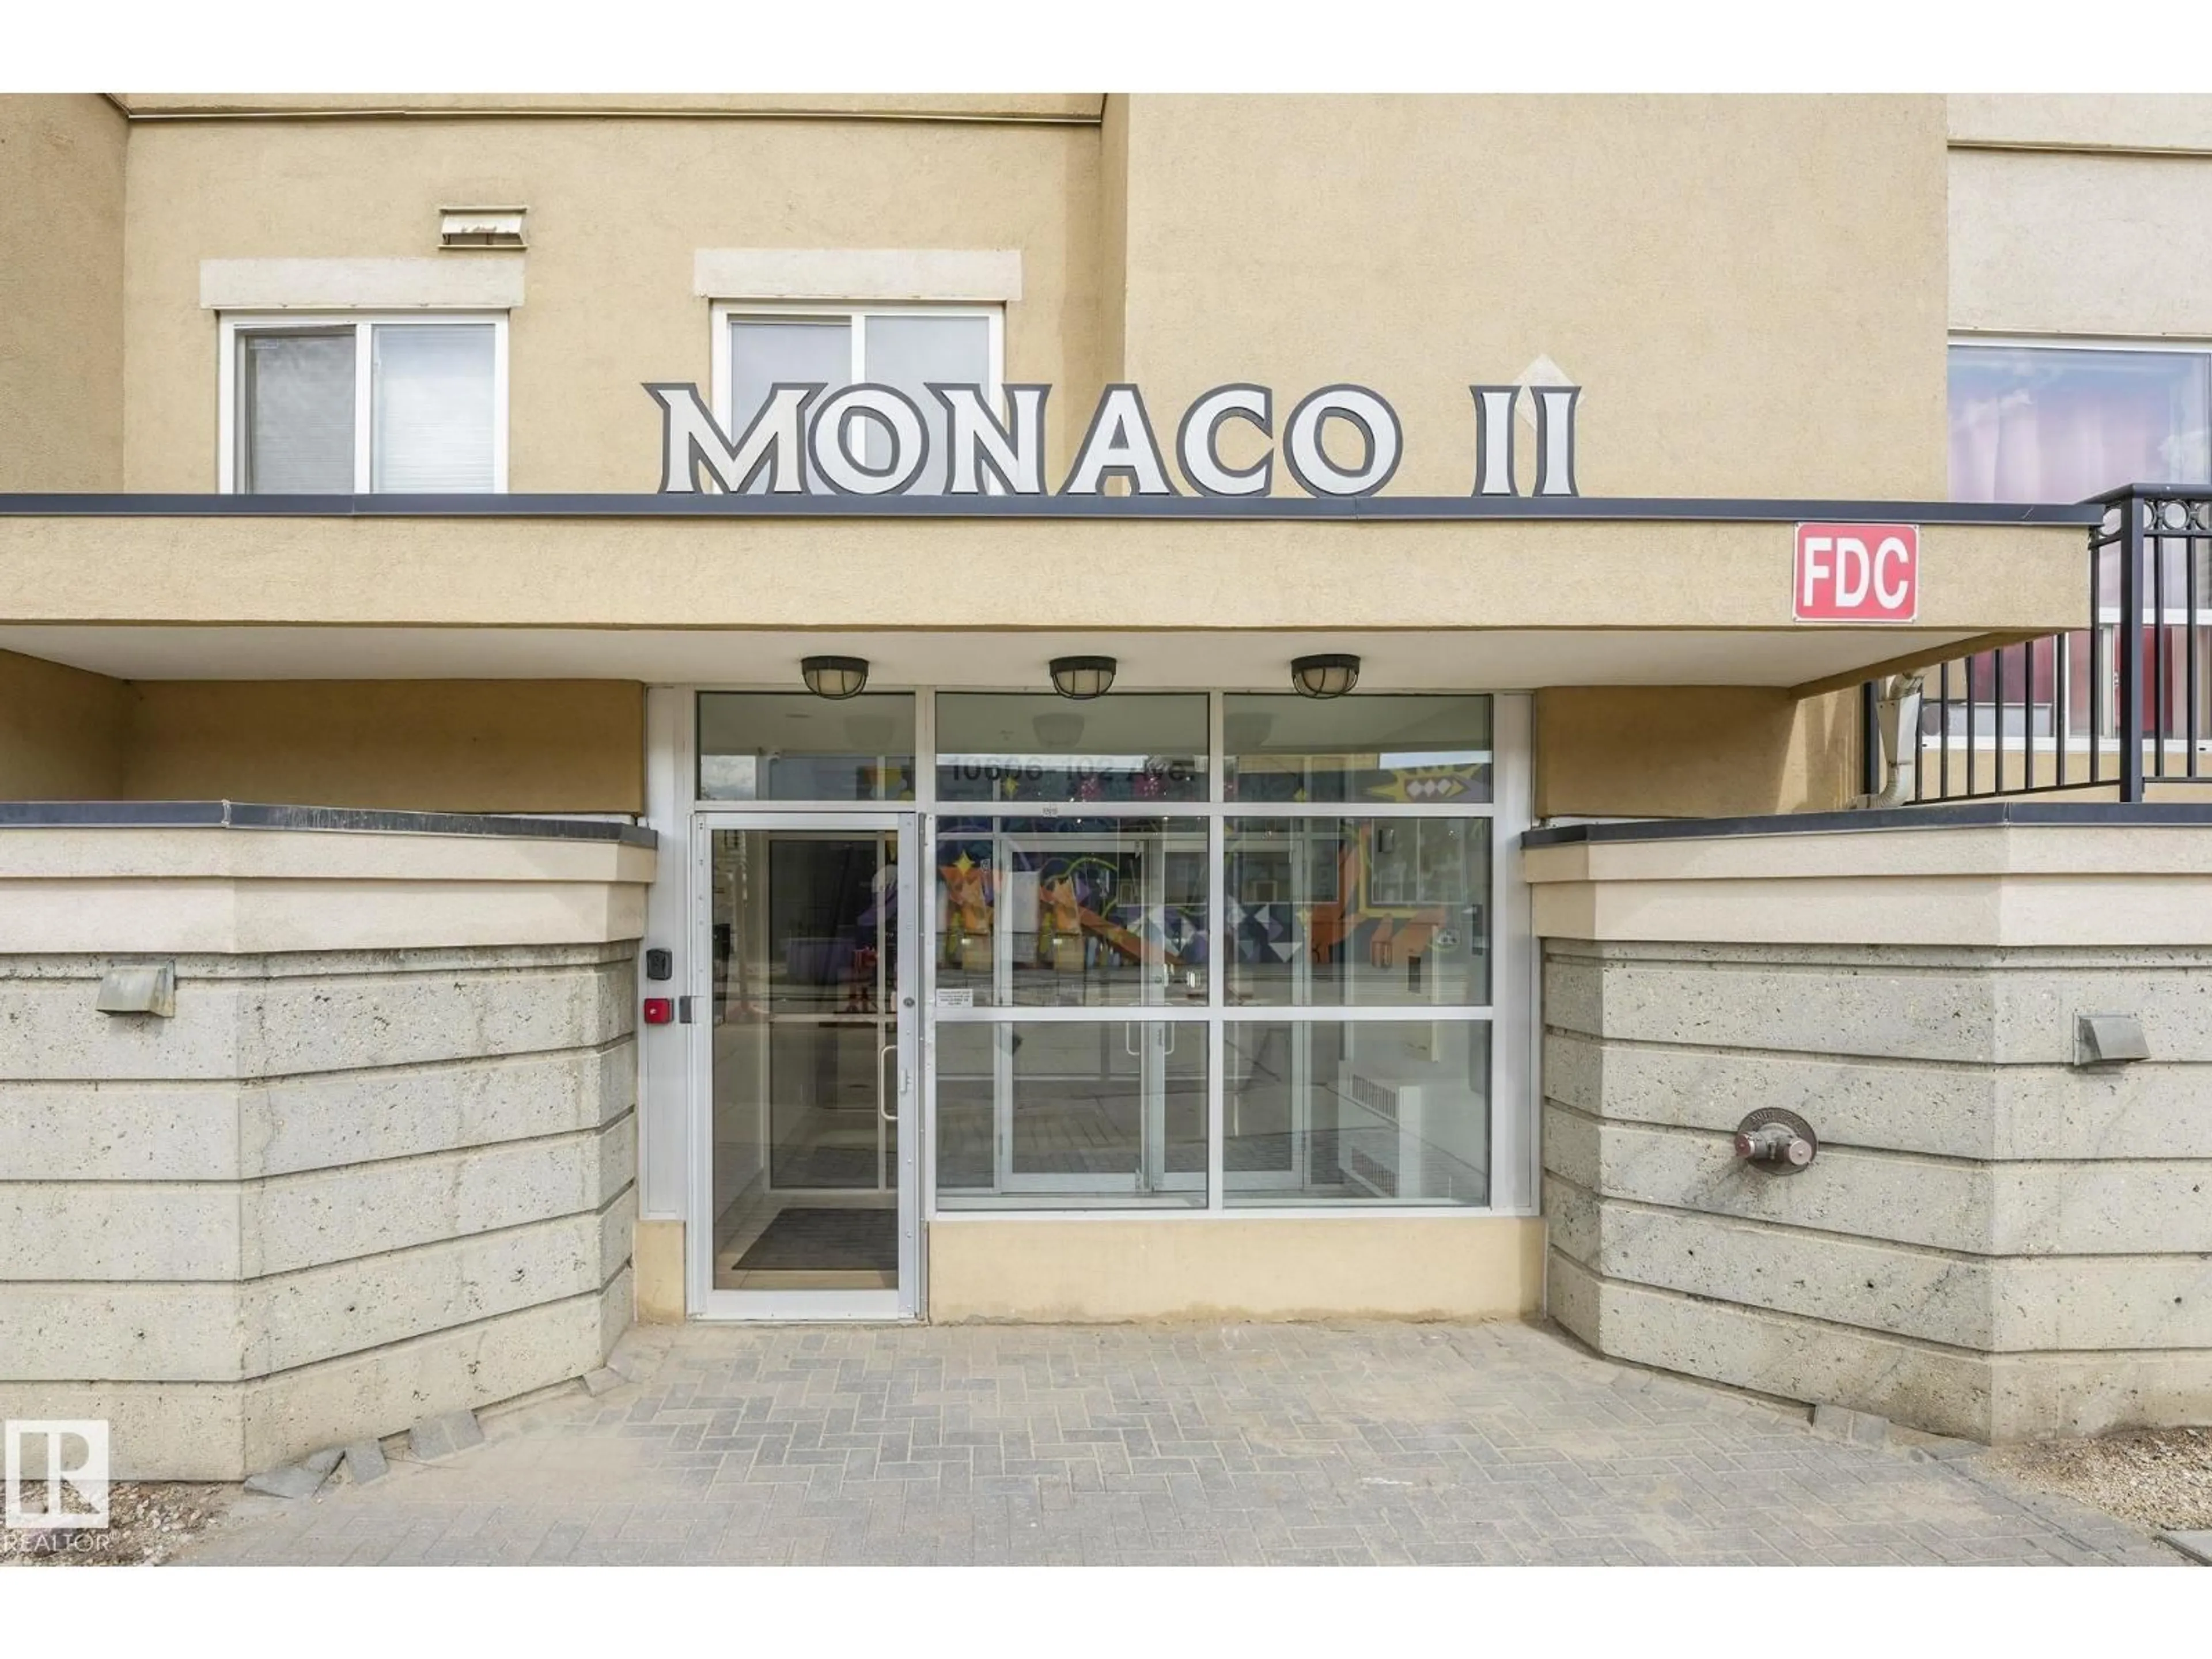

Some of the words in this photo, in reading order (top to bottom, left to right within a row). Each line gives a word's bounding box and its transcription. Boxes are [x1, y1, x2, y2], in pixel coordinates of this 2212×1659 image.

[641, 382, 1403, 497] MONACO
[1469, 385, 1582, 497] II
[1803, 536, 1909, 609] FDC
